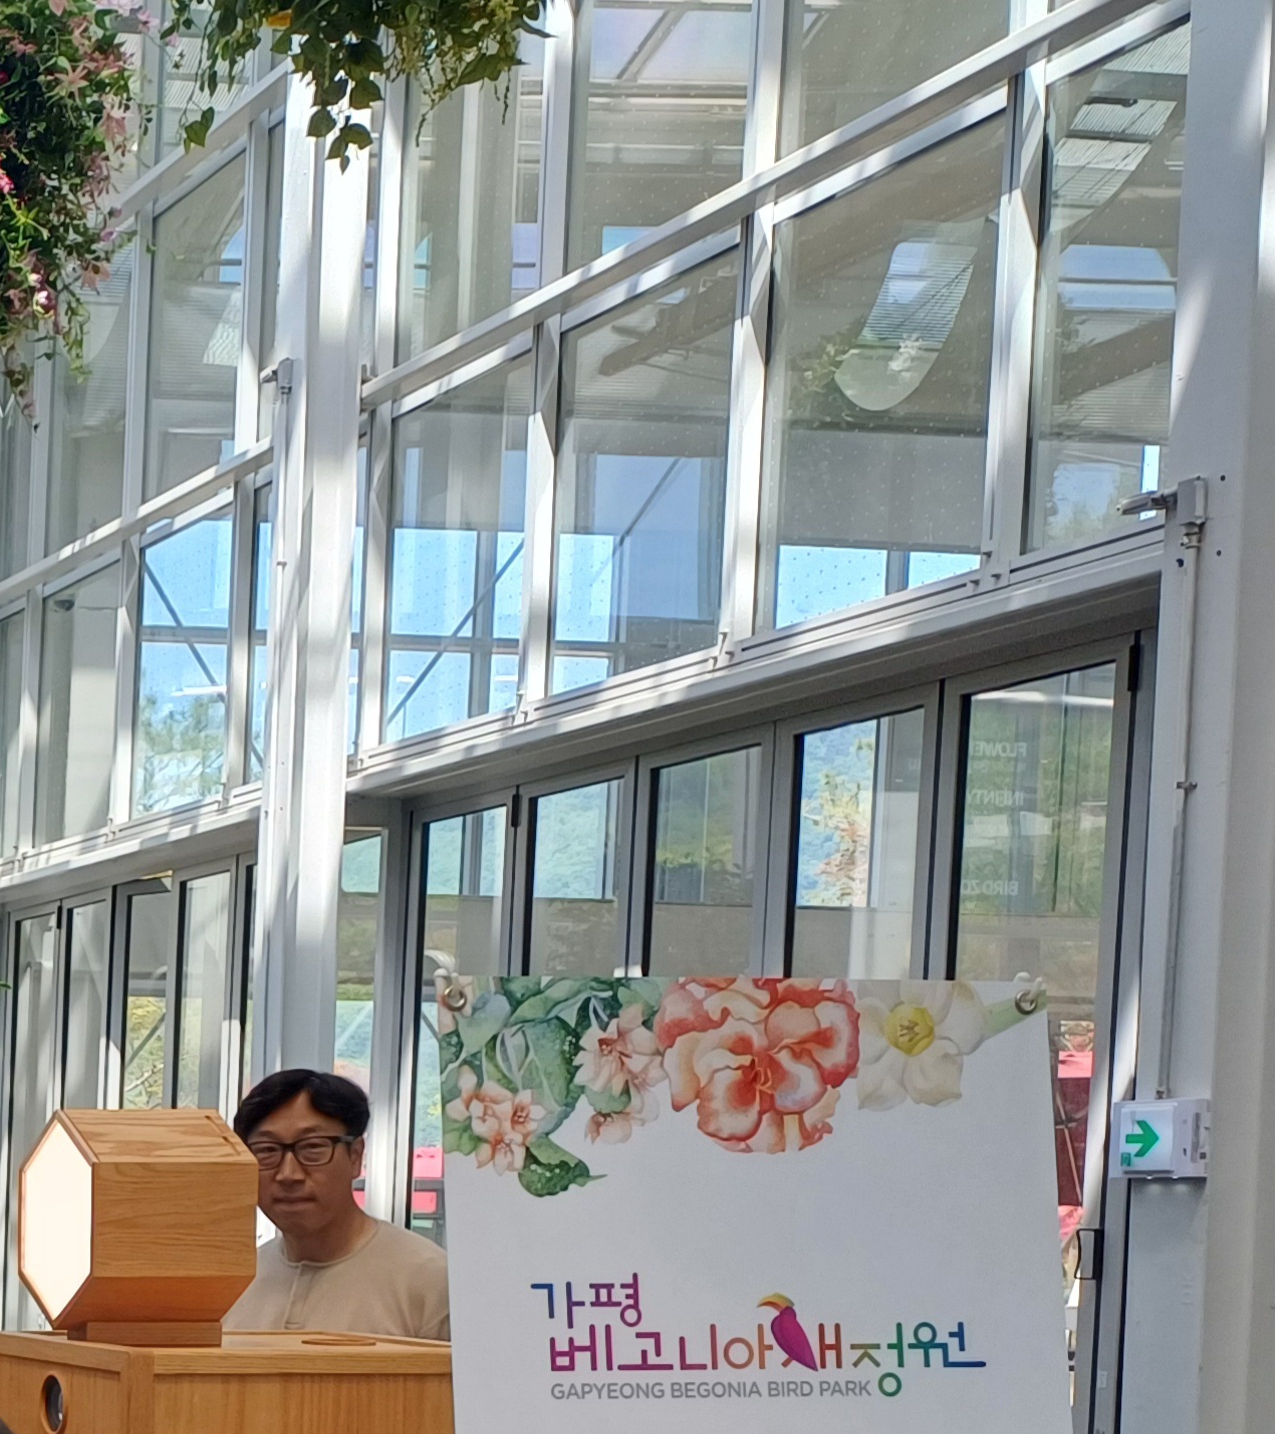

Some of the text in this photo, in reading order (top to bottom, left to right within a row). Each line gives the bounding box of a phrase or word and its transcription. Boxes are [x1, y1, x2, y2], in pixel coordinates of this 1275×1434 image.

[531, 1272, 642, 1327] 가평
[551, 1380, 872, 1400] GAPYEONG BEGONIA BIRD PARK
